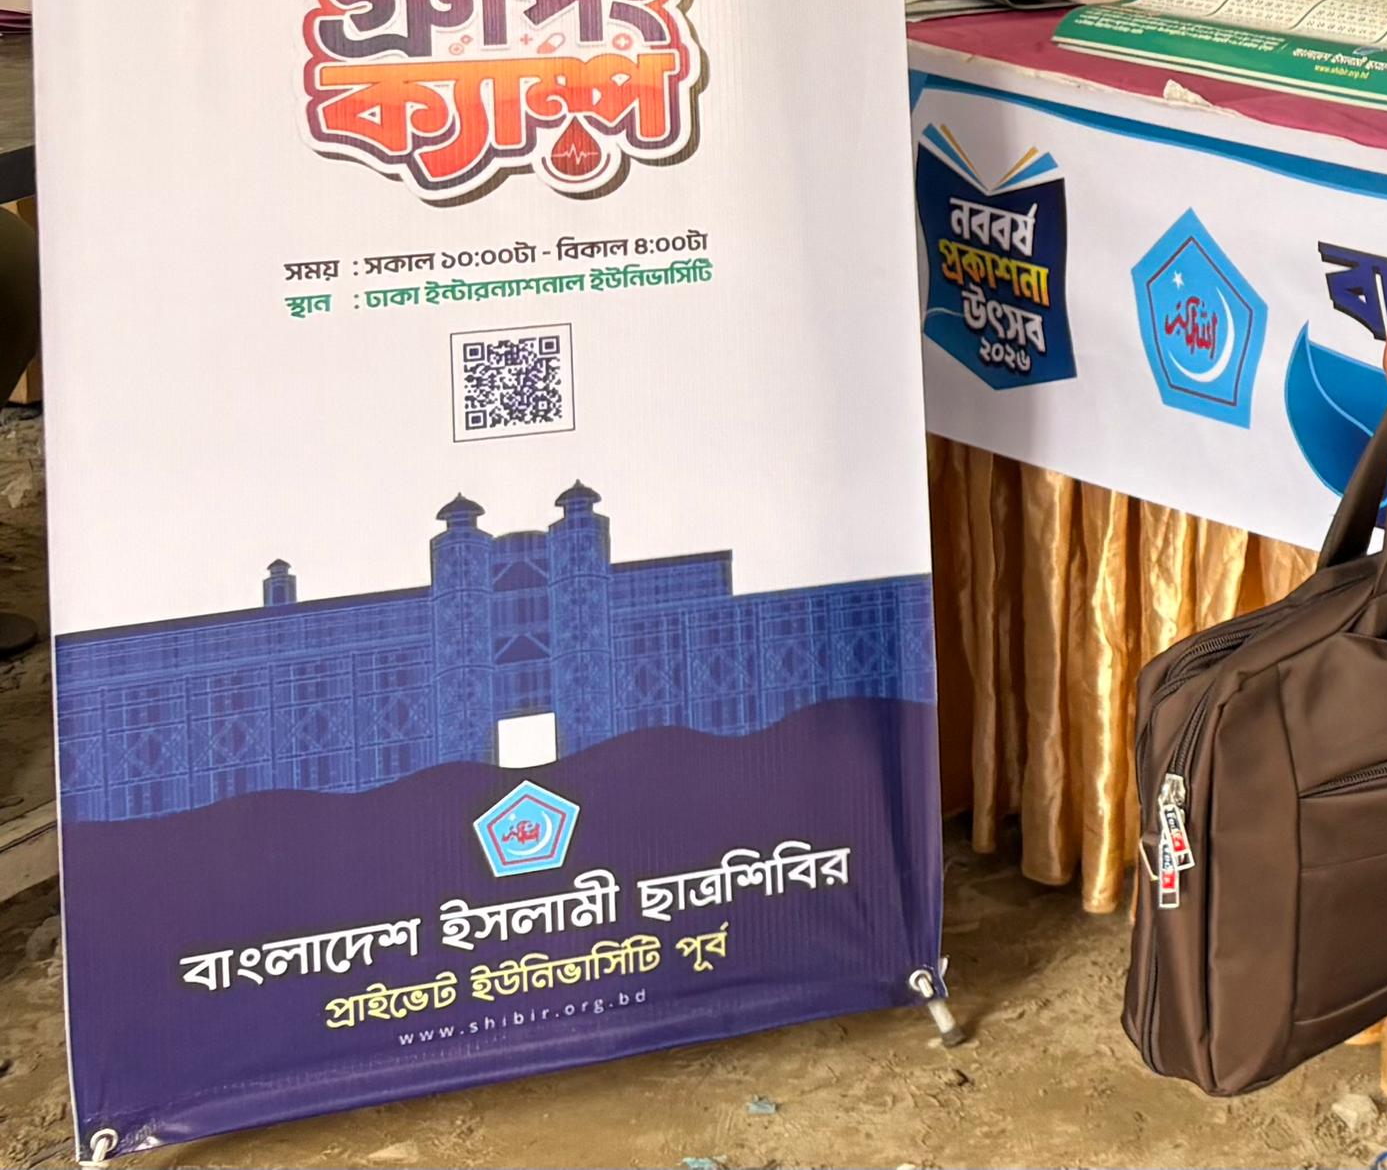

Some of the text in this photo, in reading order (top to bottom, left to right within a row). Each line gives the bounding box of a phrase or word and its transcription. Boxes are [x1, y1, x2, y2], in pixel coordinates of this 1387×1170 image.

[320, 52, 677, 180] ক্যাম্প
[284, 259, 340, 282] সময়
[365, 251, 435, 276] সকাল
[440, 241, 537, 270] ১০:০০টা
[557, 236, 628, 262] বিকাল
[633, 229, 708, 257] ৪:০০টা
[949, 195, 1037, 257] নববর্ষ
[285, 293, 332, 319] স্থান
[365, 285, 420, 310] ঢাকা
[425, 271, 585, 305] ইন্টারন্যাশনাল
[589, 257, 713, 293] ইউনিভার্সিটি
[938, 238, 1051, 309] প্রকাশনা
[960, 285, 1046, 355] উৎসব
[979, 339, 1032, 372] ২০২৬
[179, 841, 851, 992] বাংলাদেশ ইসলামী ছাত্রশিবির
[325, 921, 729, 1030] প্রাইভেট ইউনিভার্সিটি পূর্ব
[399, 988, 647, 1048] www.shibir.org.bd
